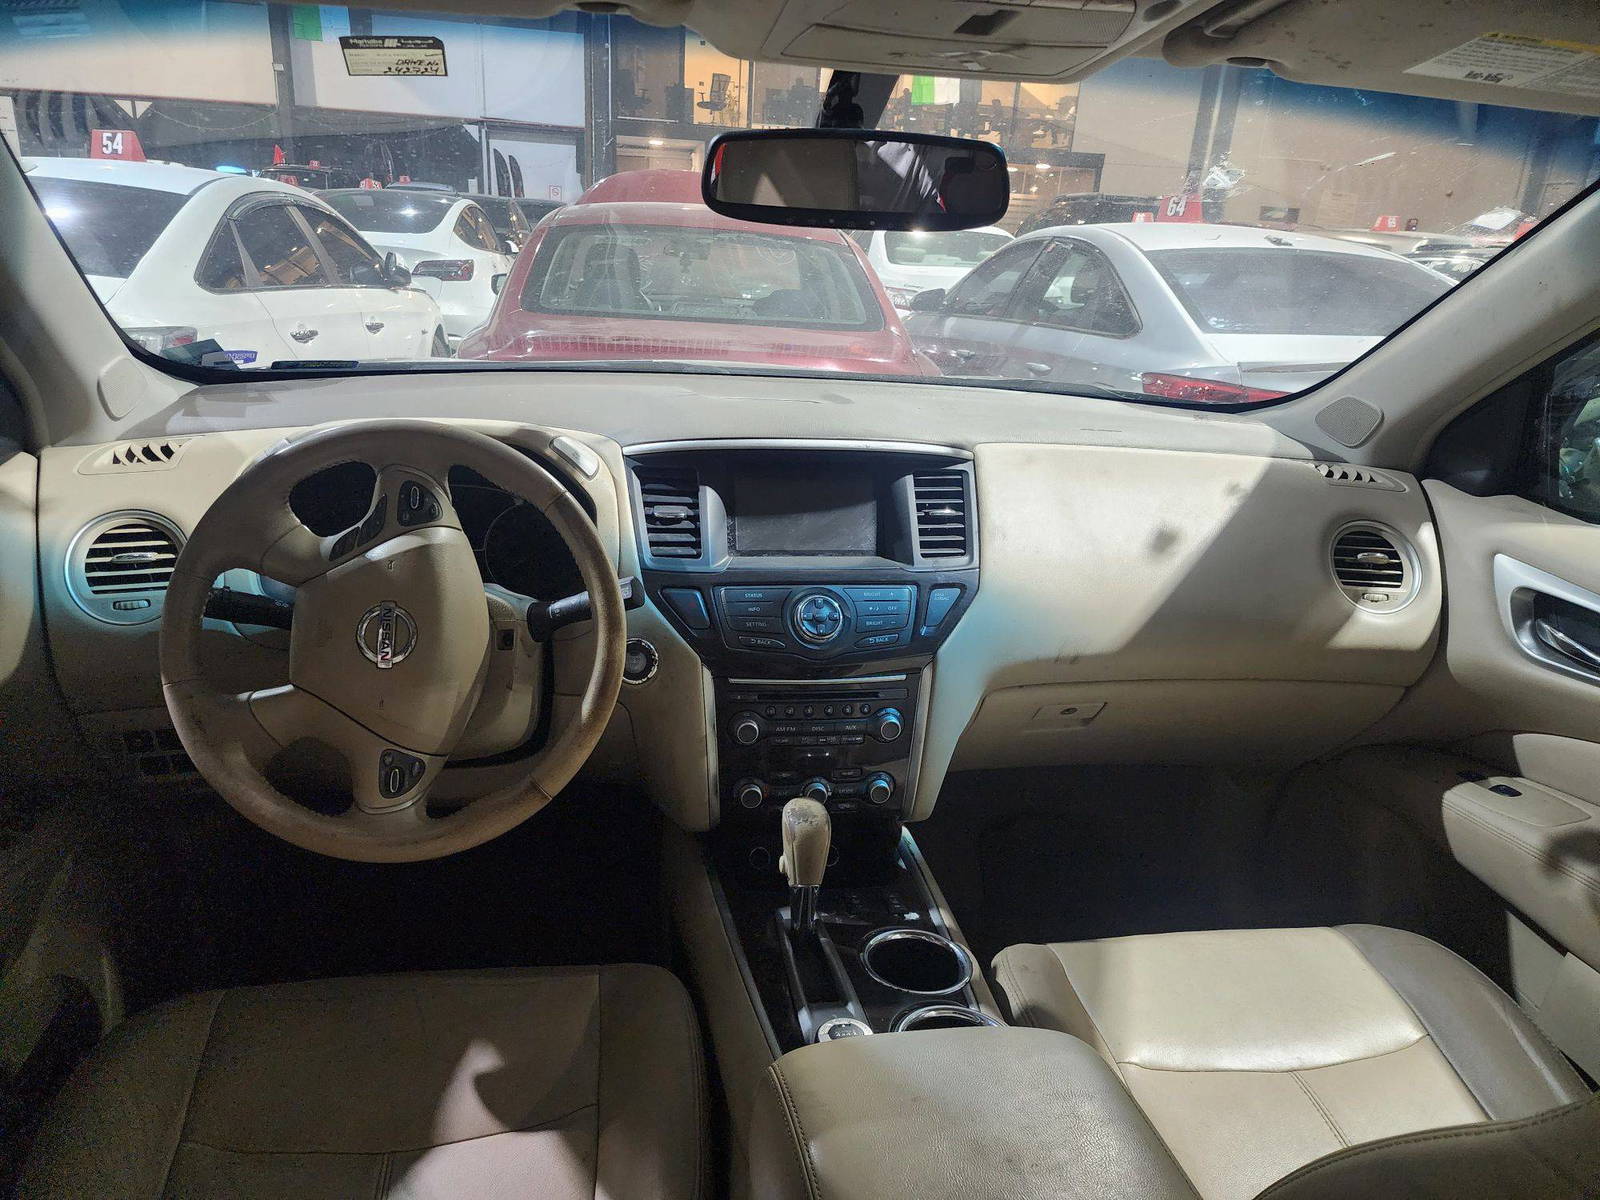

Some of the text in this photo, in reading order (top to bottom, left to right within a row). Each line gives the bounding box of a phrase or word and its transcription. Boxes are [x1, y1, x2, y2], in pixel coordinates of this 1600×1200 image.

[102, 132, 123, 155] 54
[1166, 196, 1187, 217] 64
[380, 607, 393, 661] NISSAN
